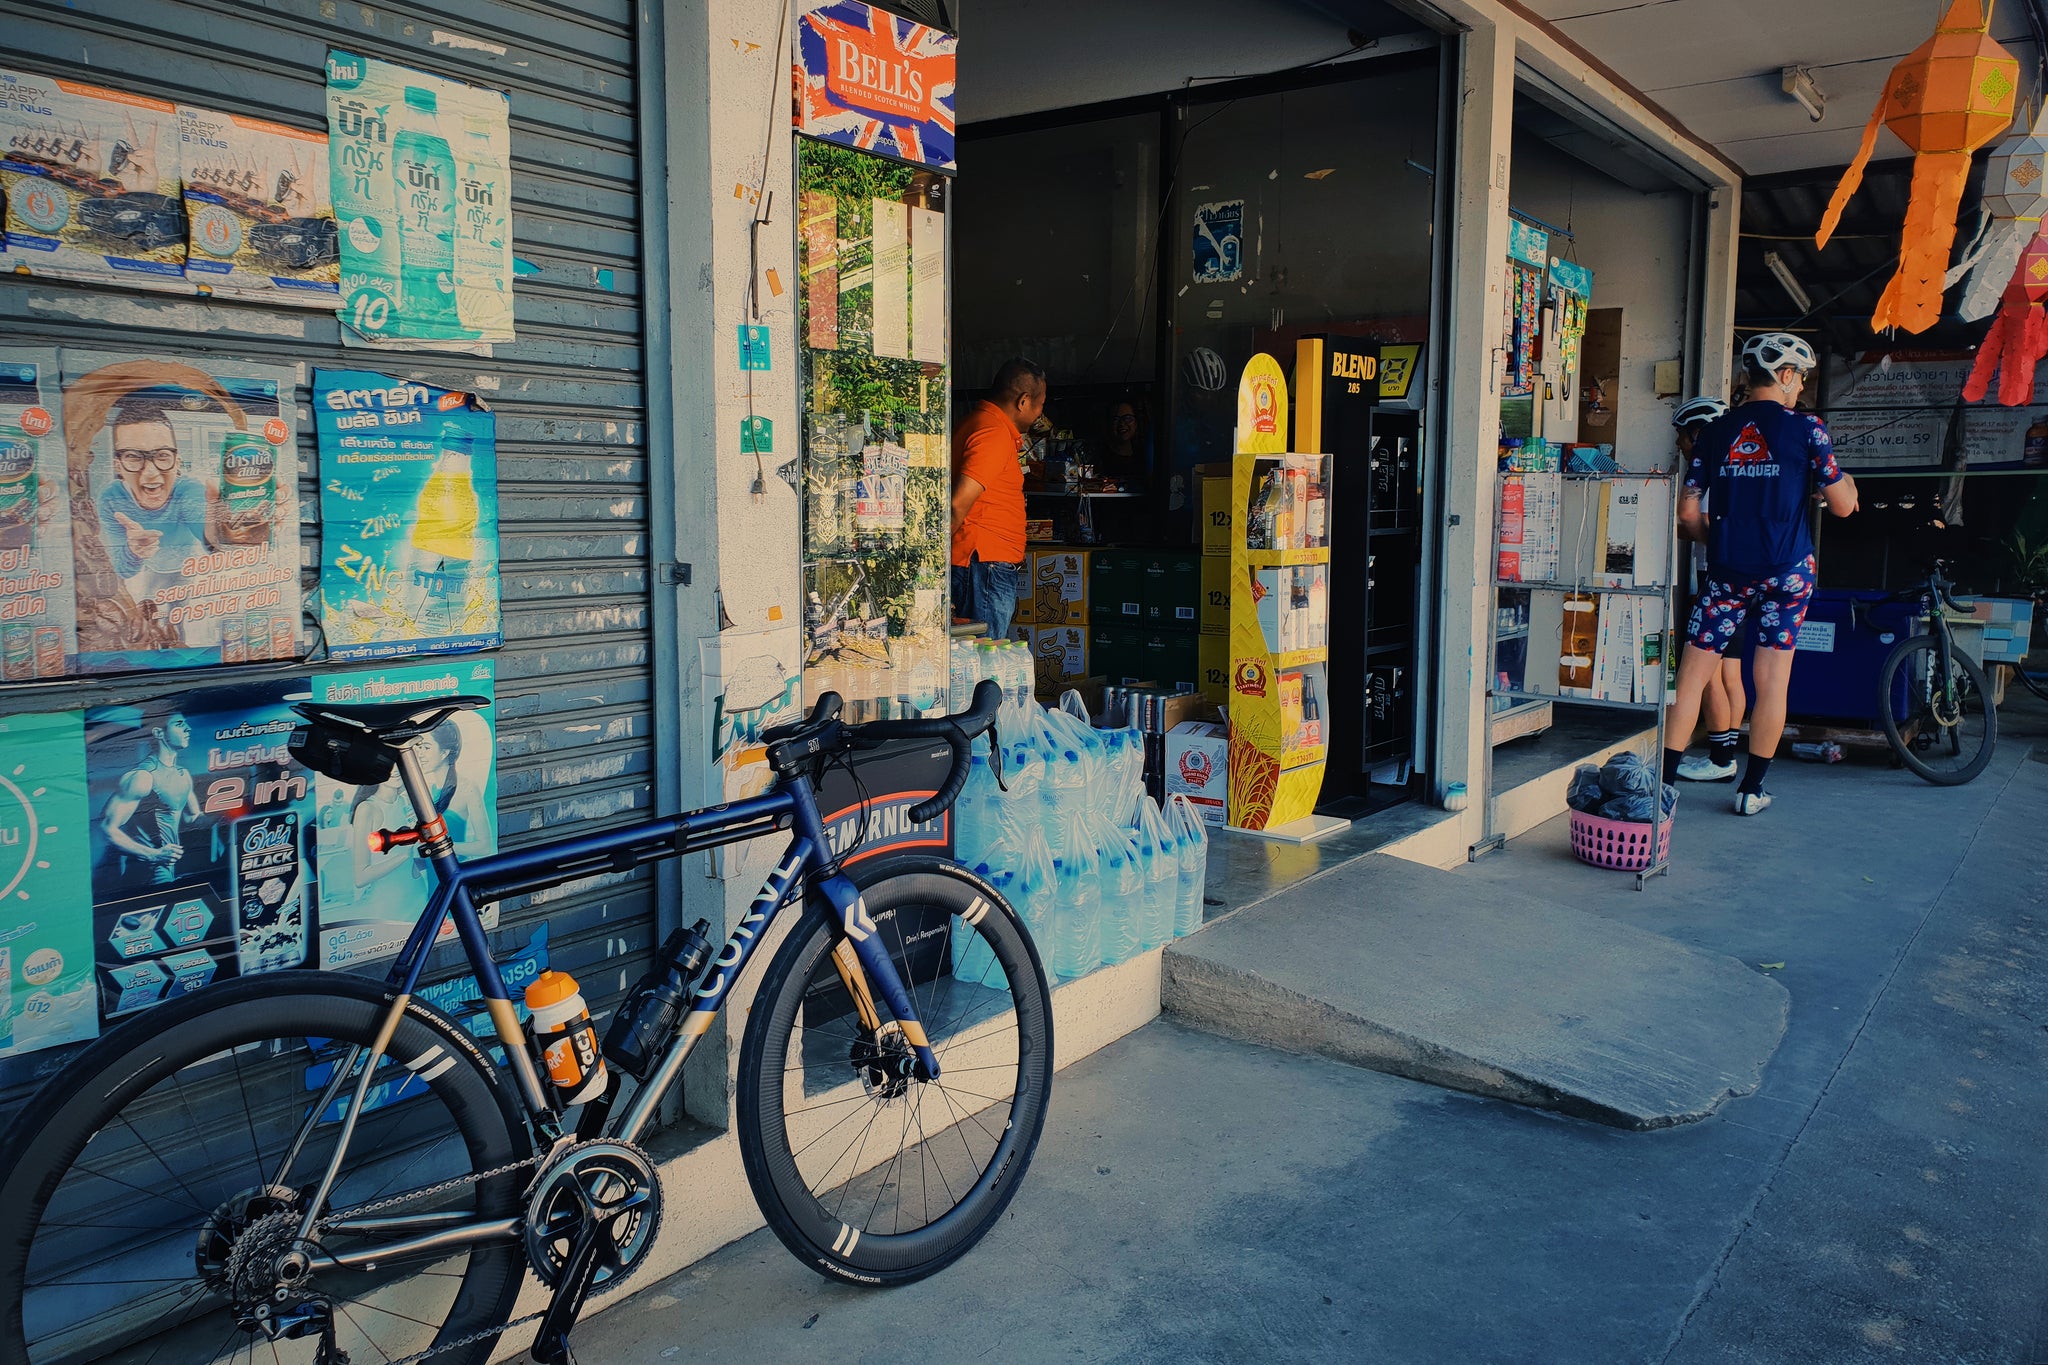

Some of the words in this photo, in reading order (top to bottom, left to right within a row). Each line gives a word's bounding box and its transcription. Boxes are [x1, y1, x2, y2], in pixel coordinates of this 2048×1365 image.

[328, 59, 358, 80] ใหม่
[838, 38, 923, 103] BELL'S
[0, 91, 37, 104] EASY
[840, 84, 872, 99] BLENDED
[874, 94, 897, 107] SCOTCH
[899, 101, 920, 114] WHISKY
[180, 118, 224, 131] HAPPY
[339, 101, 387, 142] บิ๊ก
[180, 126, 215, 139] EASY
[343, 272, 367, 290] 400
[353, 294, 389, 329] 10
[1332, 351, 1377, 380] BLEND
[326, 380, 429, 410] สตาร์ท
[1347, 382, 1360, 393] 285
[1858, 434, 1875, 445] 30
[1913, 433, 1930, 445] 59
[1720, 464, 1780, 478] ATTAQUER
[326, 479, 368, 501] ZINC
[361, 513, 401, 539] ZINC
[335, 543, 404, 595] ZINC
[808, 737, 820, 753] 3T
[208, 743, 292, 771] โปรตีนสู
[205, 777, 245, 813] 2
[254, 771, 307, 805] เท่า
[241, 850, 294, 872] BLACK
[172, 913, 204, 933] 10
[920, 923, 947, 940] Responsibly
[428, 1012, 453, 1032] PRIX
